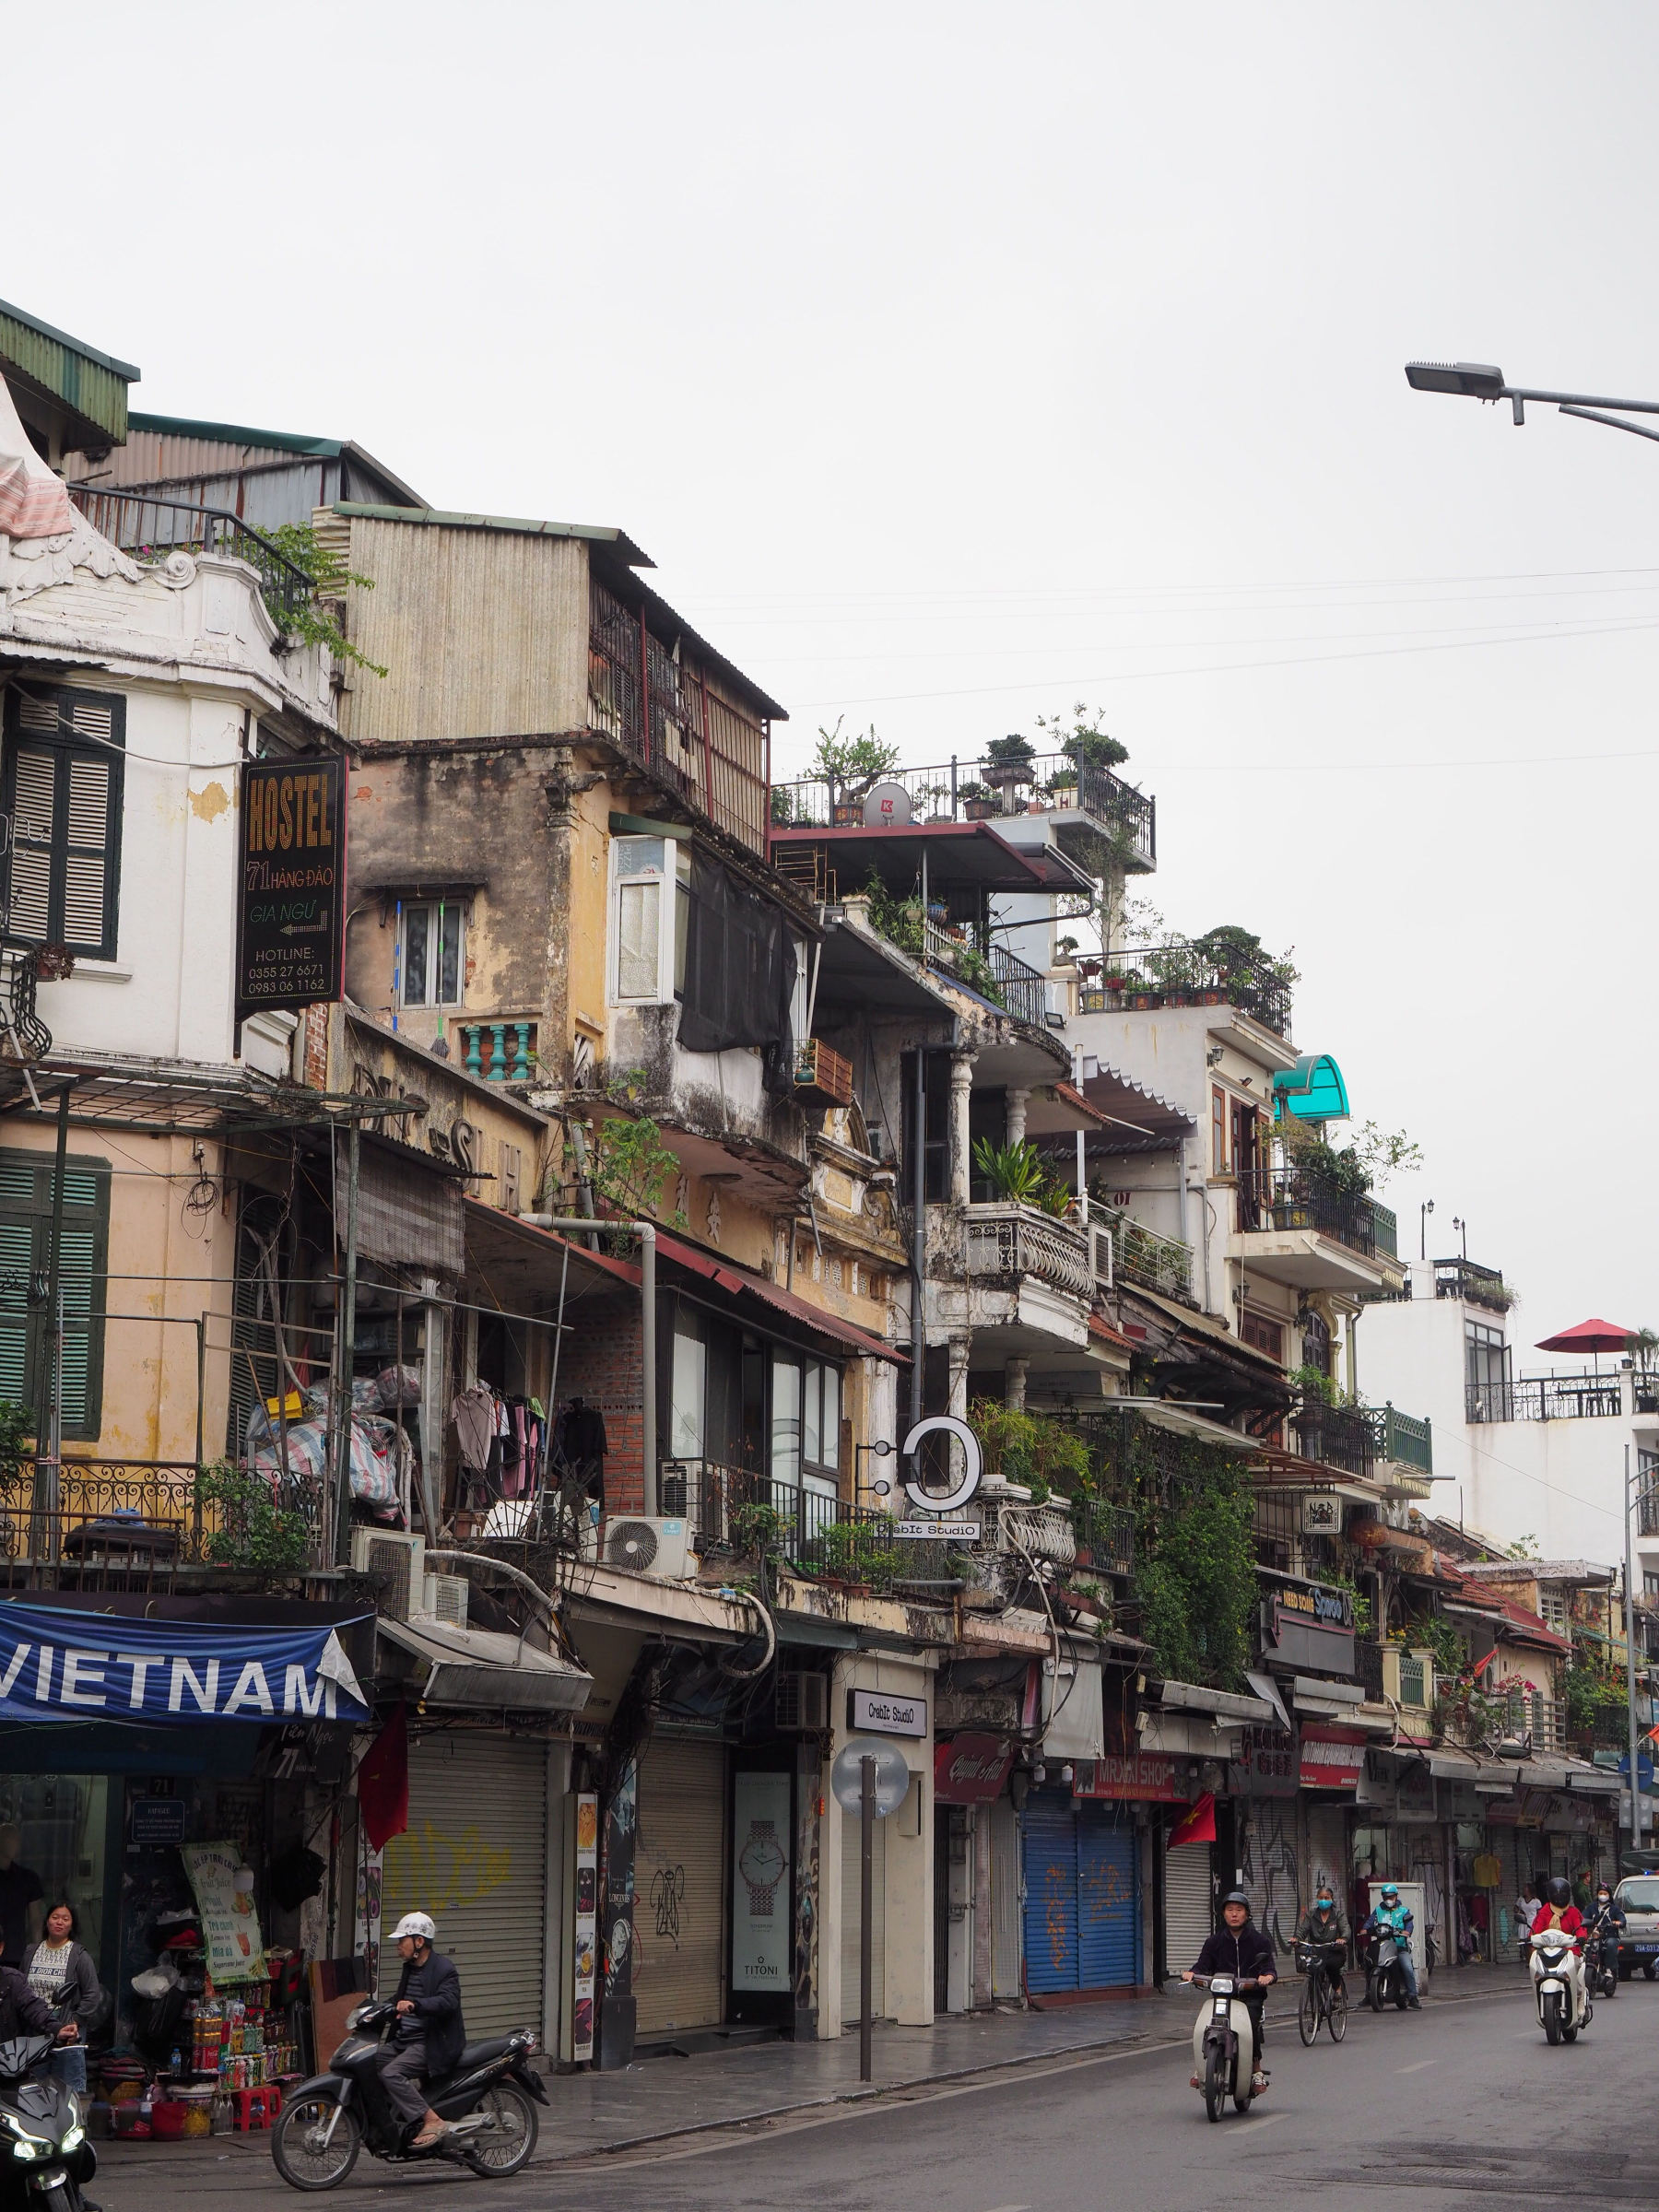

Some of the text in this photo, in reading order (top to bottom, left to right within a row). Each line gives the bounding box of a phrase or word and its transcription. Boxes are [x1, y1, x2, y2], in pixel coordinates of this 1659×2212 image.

[249, 774, 332, 852] HOSTEL
[247, 861, 270, 891] 71
[271, 868, 304, 889] HÀNG
[250, 905, 276, 923] GIA
[255, 947, 315, 962] HOTLINE:
[249, 964, 324, 979] 0355 27 6671
[248, 979, 324, 994] 0983 06 1162
[1283, 1590, 1299, 1609] NEED
[1299, 1594, 1314, 1614] SOME
[0, 1643, 336, 1720] VIETNAM
[1140, 1760, 1168, 1785] SHOP
[608, 1893, 630, 1903] LONGINES
[744, 1965, 778, 1975] TITONI
